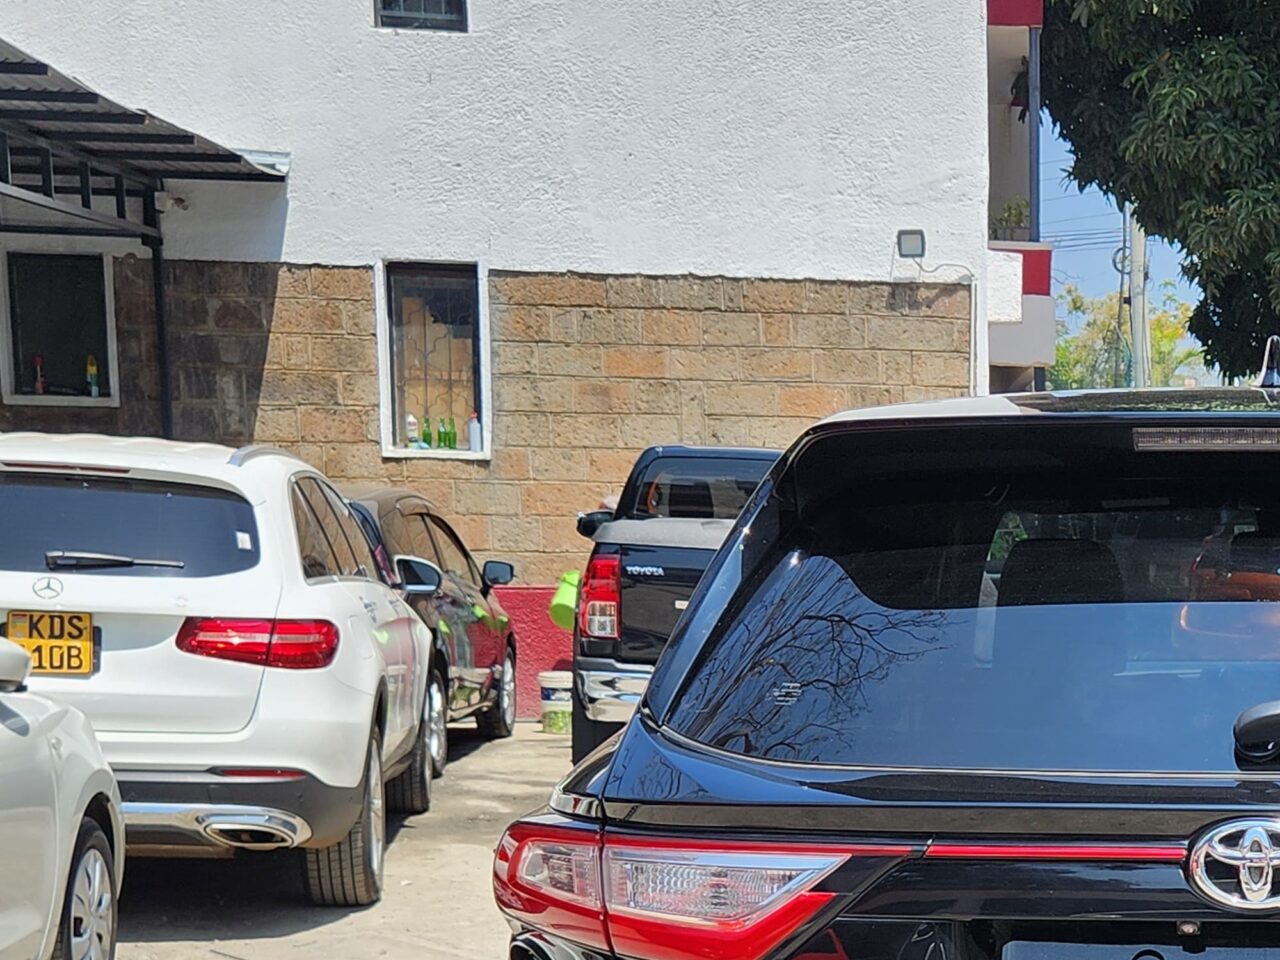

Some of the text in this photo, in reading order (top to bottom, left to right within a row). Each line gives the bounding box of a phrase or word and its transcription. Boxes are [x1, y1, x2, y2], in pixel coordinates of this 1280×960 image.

[626, 565, 665, 576] TOYOTA
[29, 613, 84, 640] KDS
[18, 643, 84, 670] 10B
